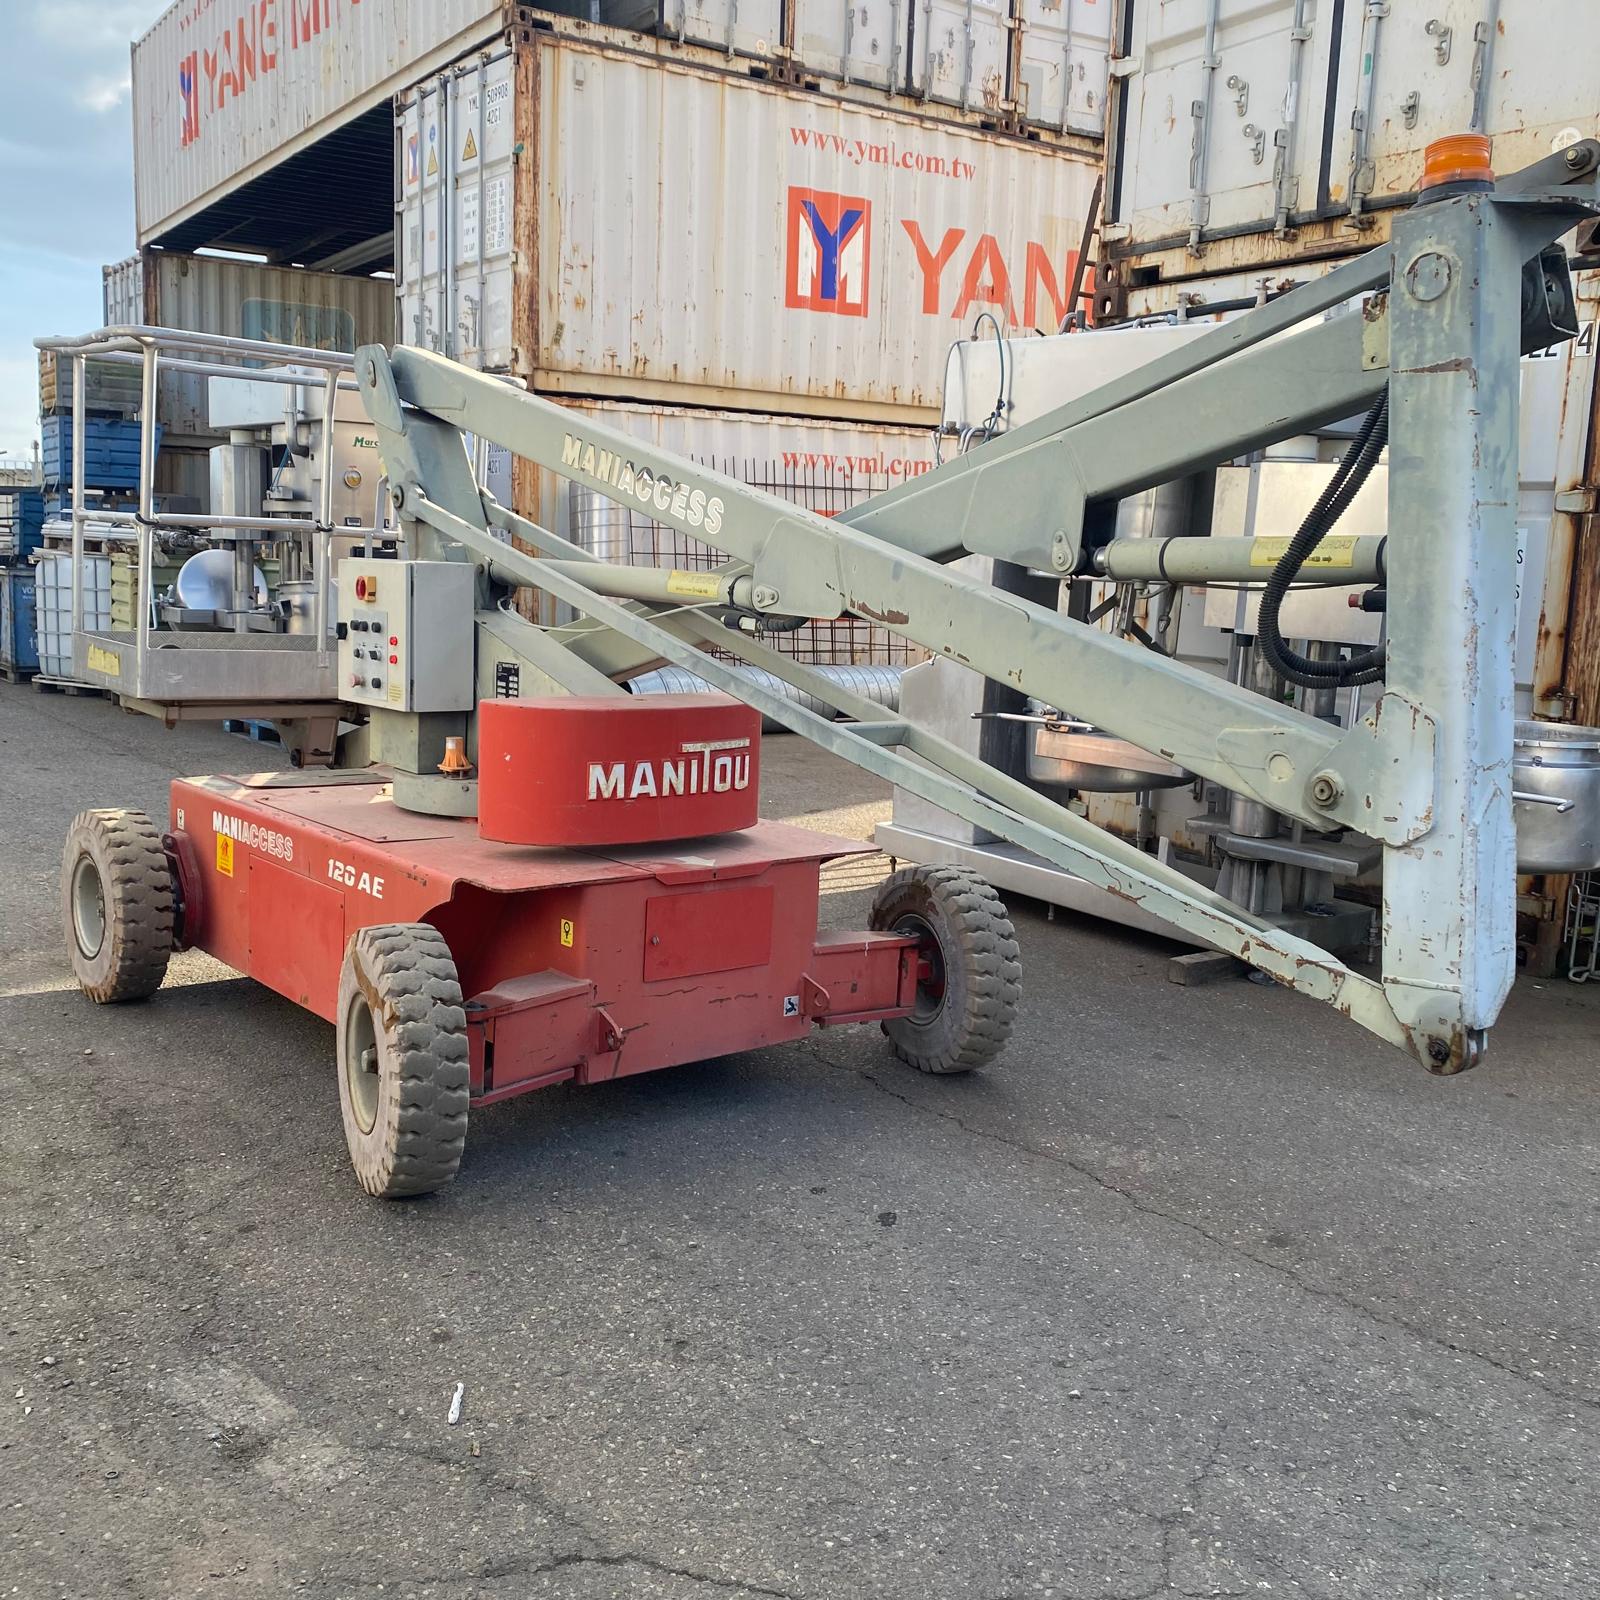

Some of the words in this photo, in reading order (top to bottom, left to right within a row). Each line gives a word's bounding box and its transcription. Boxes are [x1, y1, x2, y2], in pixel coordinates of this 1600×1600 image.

[790, 127, 976, 181] www.yml.com.tw
[561, 432, 725, 535] MANIACCESS
[587, 738, 751, 801] MANITOU
[212, 810, 294, 862] MANIACCESS
